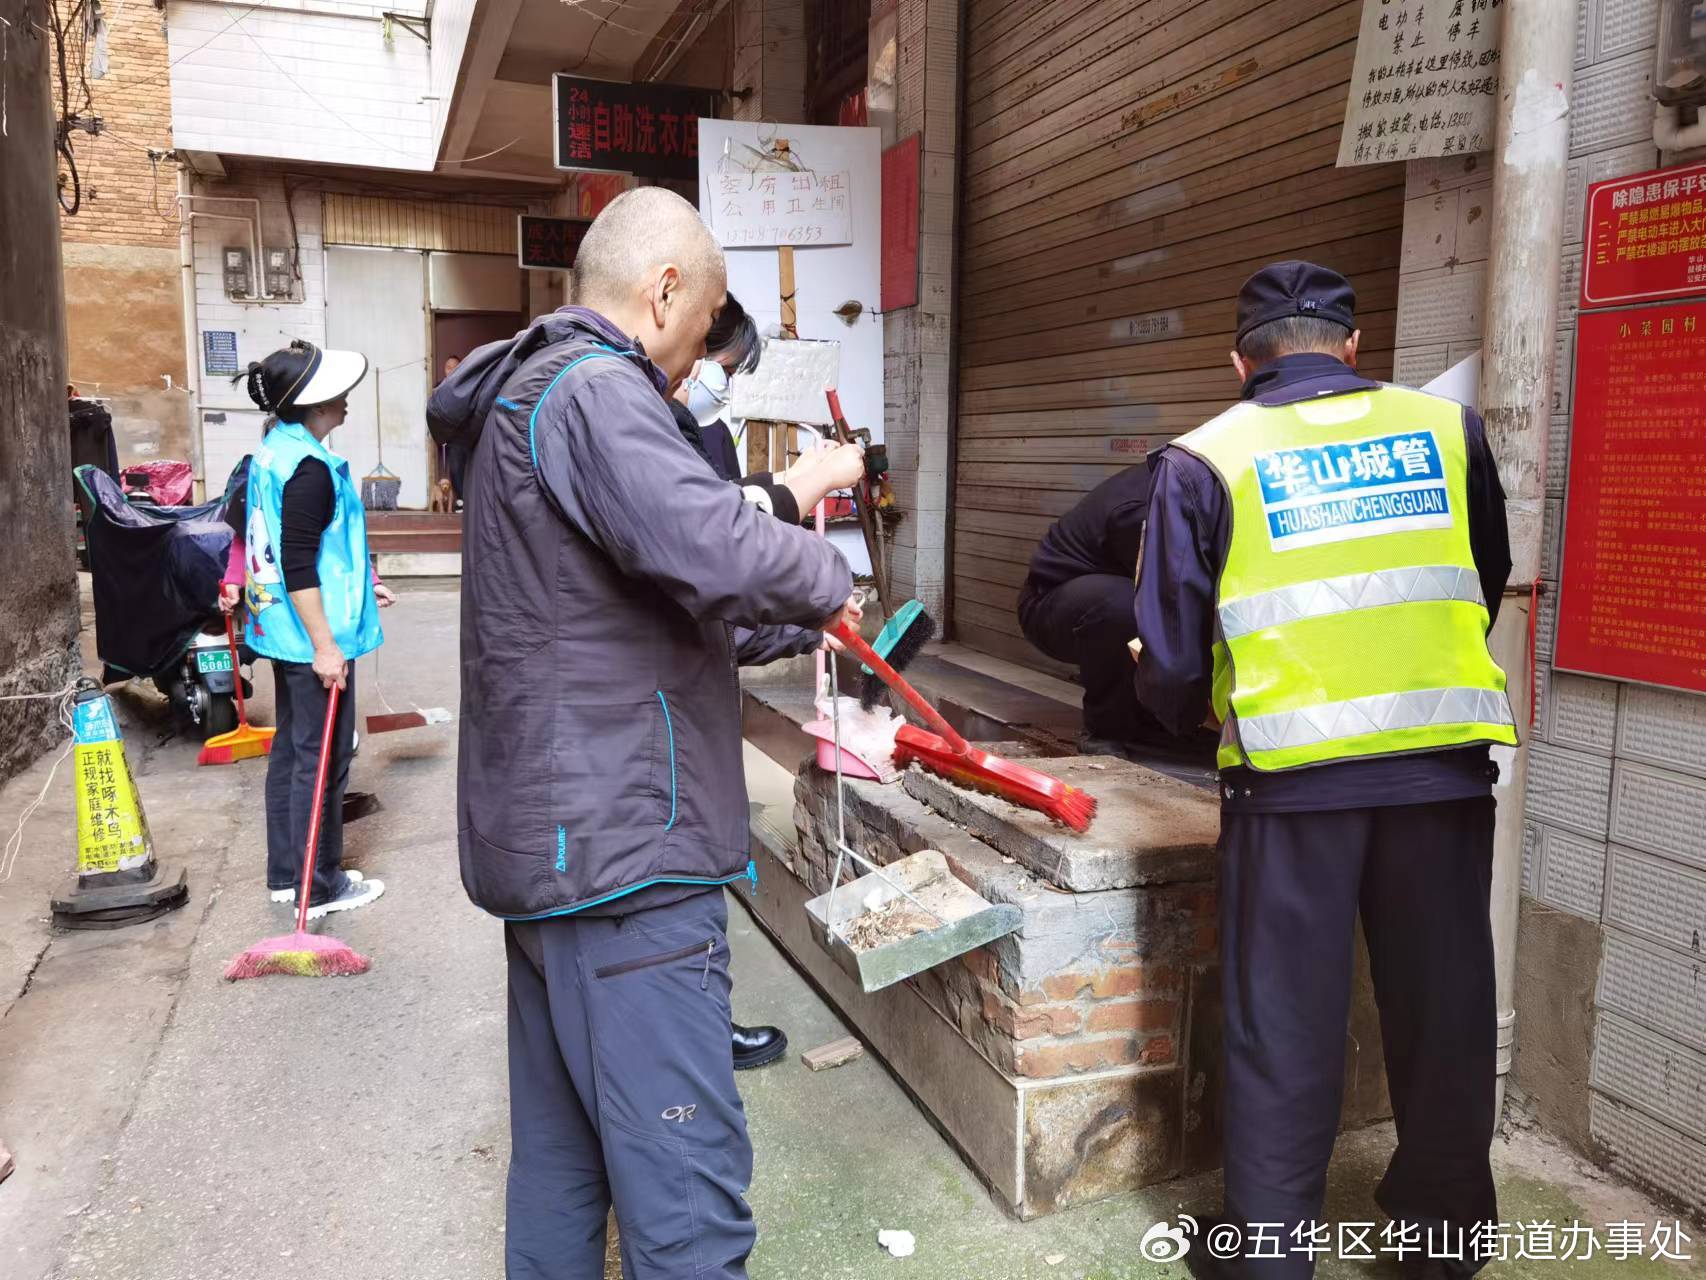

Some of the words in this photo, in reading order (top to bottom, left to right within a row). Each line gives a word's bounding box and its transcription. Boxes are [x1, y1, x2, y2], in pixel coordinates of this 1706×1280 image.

[1448, 19, 1480, 42] 停车
[570, 87, 589, 102] 24
[594, 101, 699, 159] 自助洗衣店
[720, 174, 845, 195] 空房出租
[721, 194, 845, 217] 公用卫生间
[1264, 437, 1432, 494] 华山城管
[1277, 490, 1444, 534] HUASHANCHENGGUAN
[82, 750, 105, 843] 正规家庭维修
